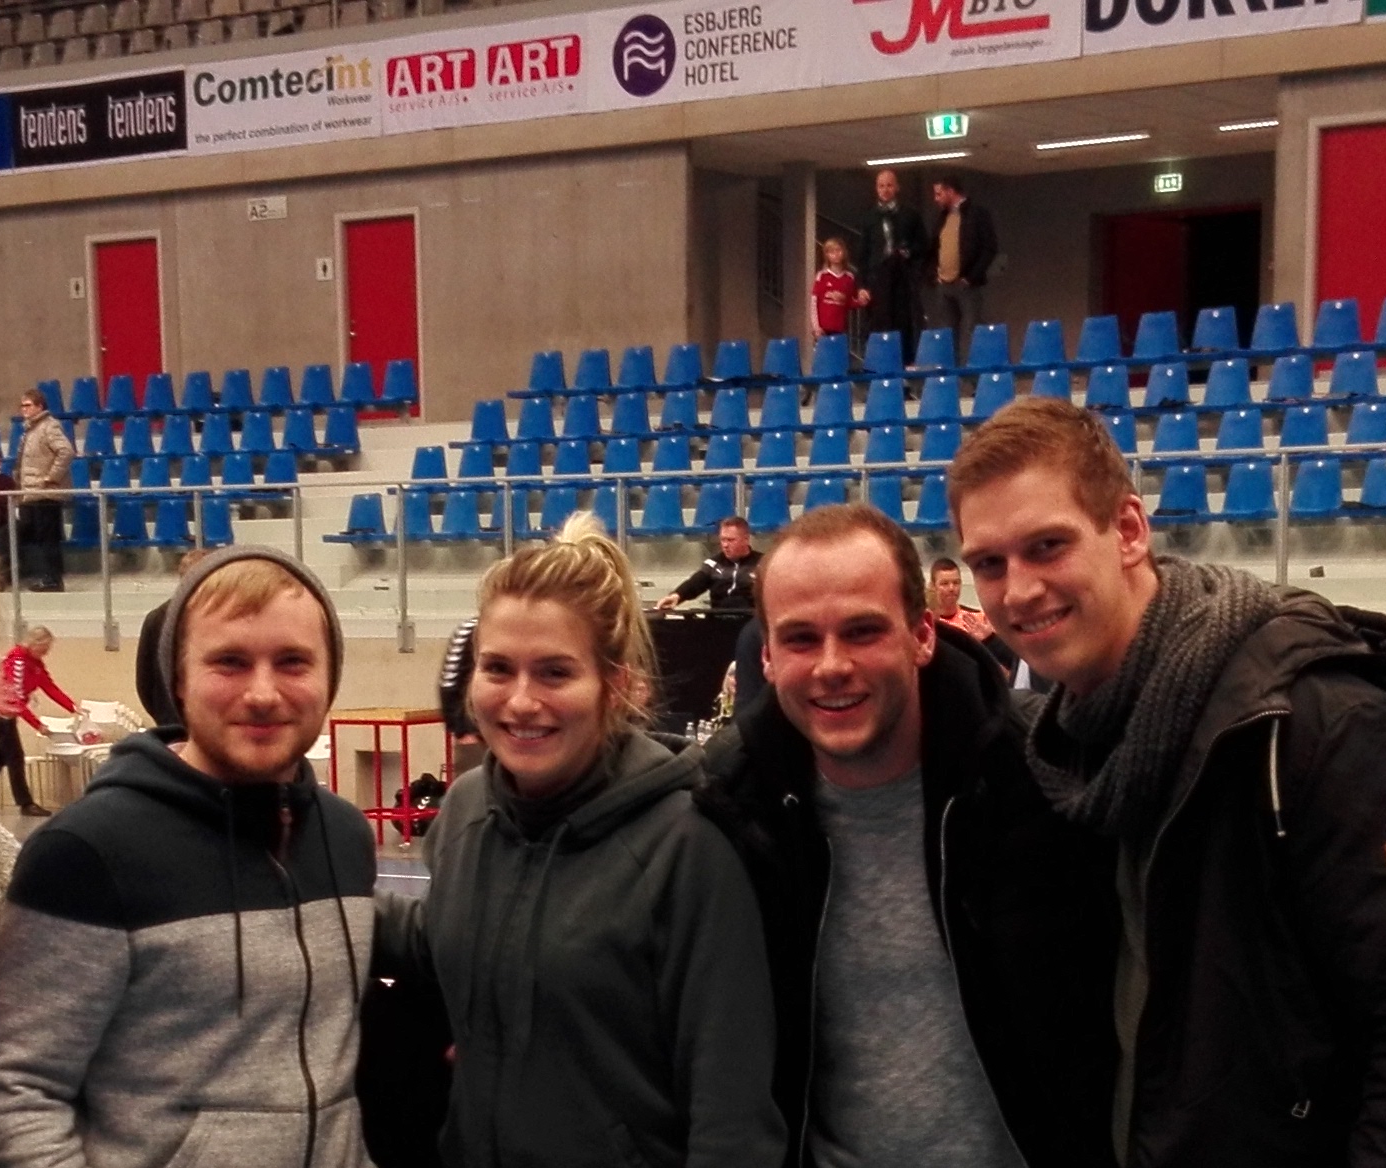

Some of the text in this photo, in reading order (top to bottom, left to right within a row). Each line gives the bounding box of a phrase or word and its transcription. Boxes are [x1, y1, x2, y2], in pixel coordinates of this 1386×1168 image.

[684, 5, 762, 34] ESBJERG
[684, 28, 798, 61] CONFERENCE
[391, 51, 471, 97] ART
[491, 38, 574, 86] ART
[685, 61, 740, 86] HOTEL
[327, 94, 373, 107] Workwear
[488, 82, 565, 101] service A/S
[107, 90, 178, 140] tendens
[389, 99, 433, 114] service
[20, 102, 89, 149] tendens
[195, 115, 373, 144] the perfect combination of workwear
[250, 204, 269, 219] A2
